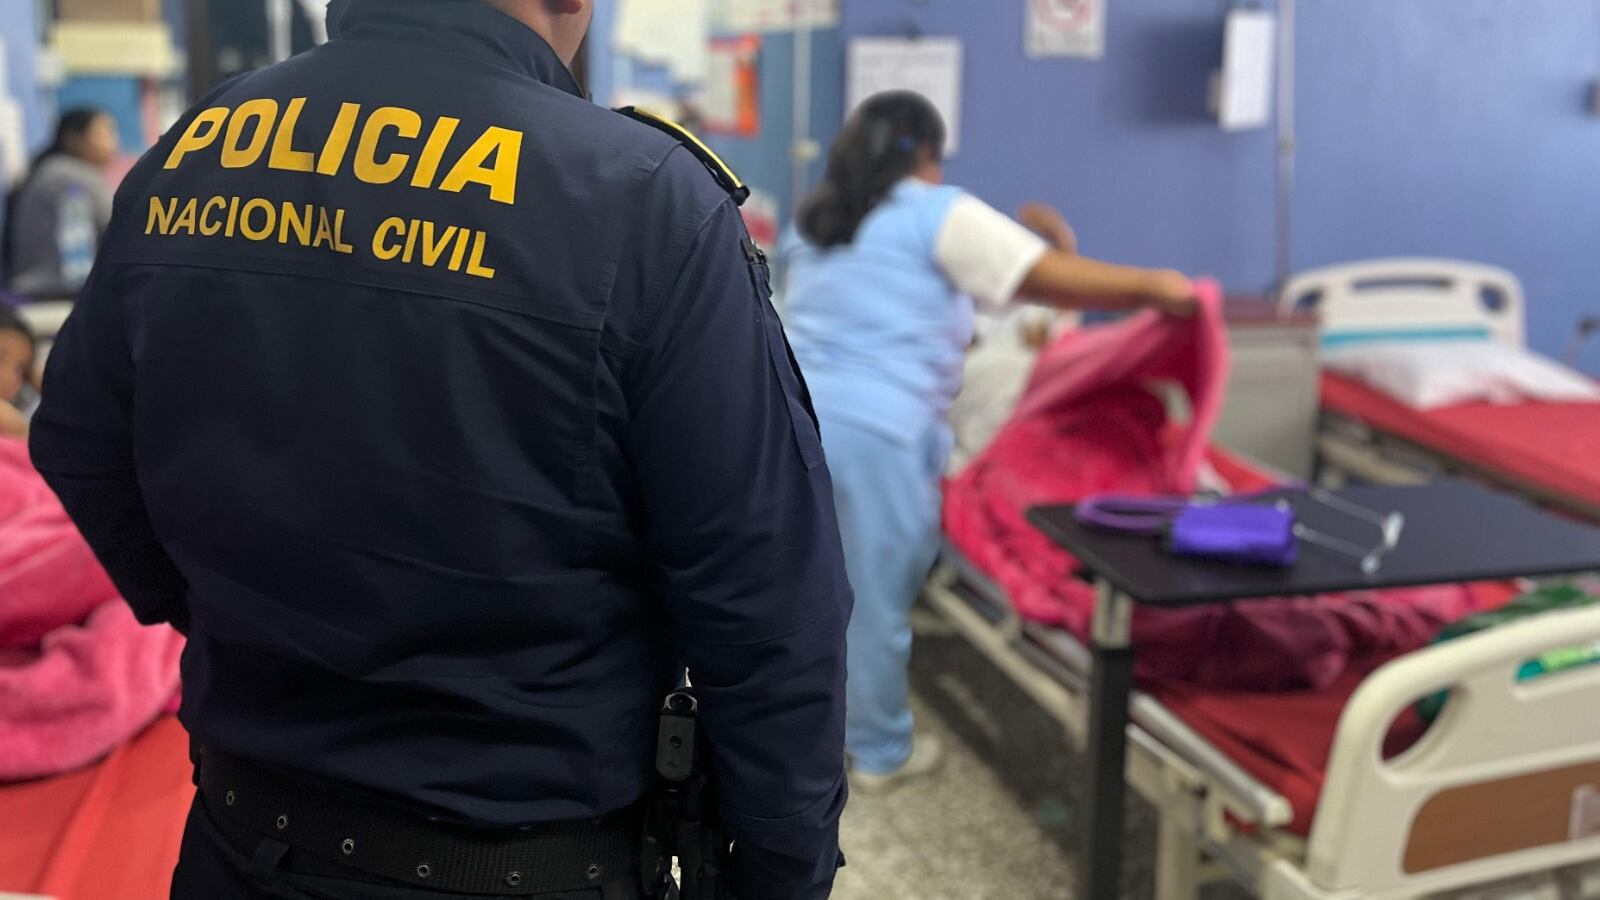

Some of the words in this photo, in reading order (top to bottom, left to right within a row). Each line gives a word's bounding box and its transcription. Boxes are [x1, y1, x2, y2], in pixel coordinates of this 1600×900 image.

[164, 97, 523, 205] POLICIA
[145, 196, 353, 254] NACIONAL
[372, 216, 495, 279] CIVIL
